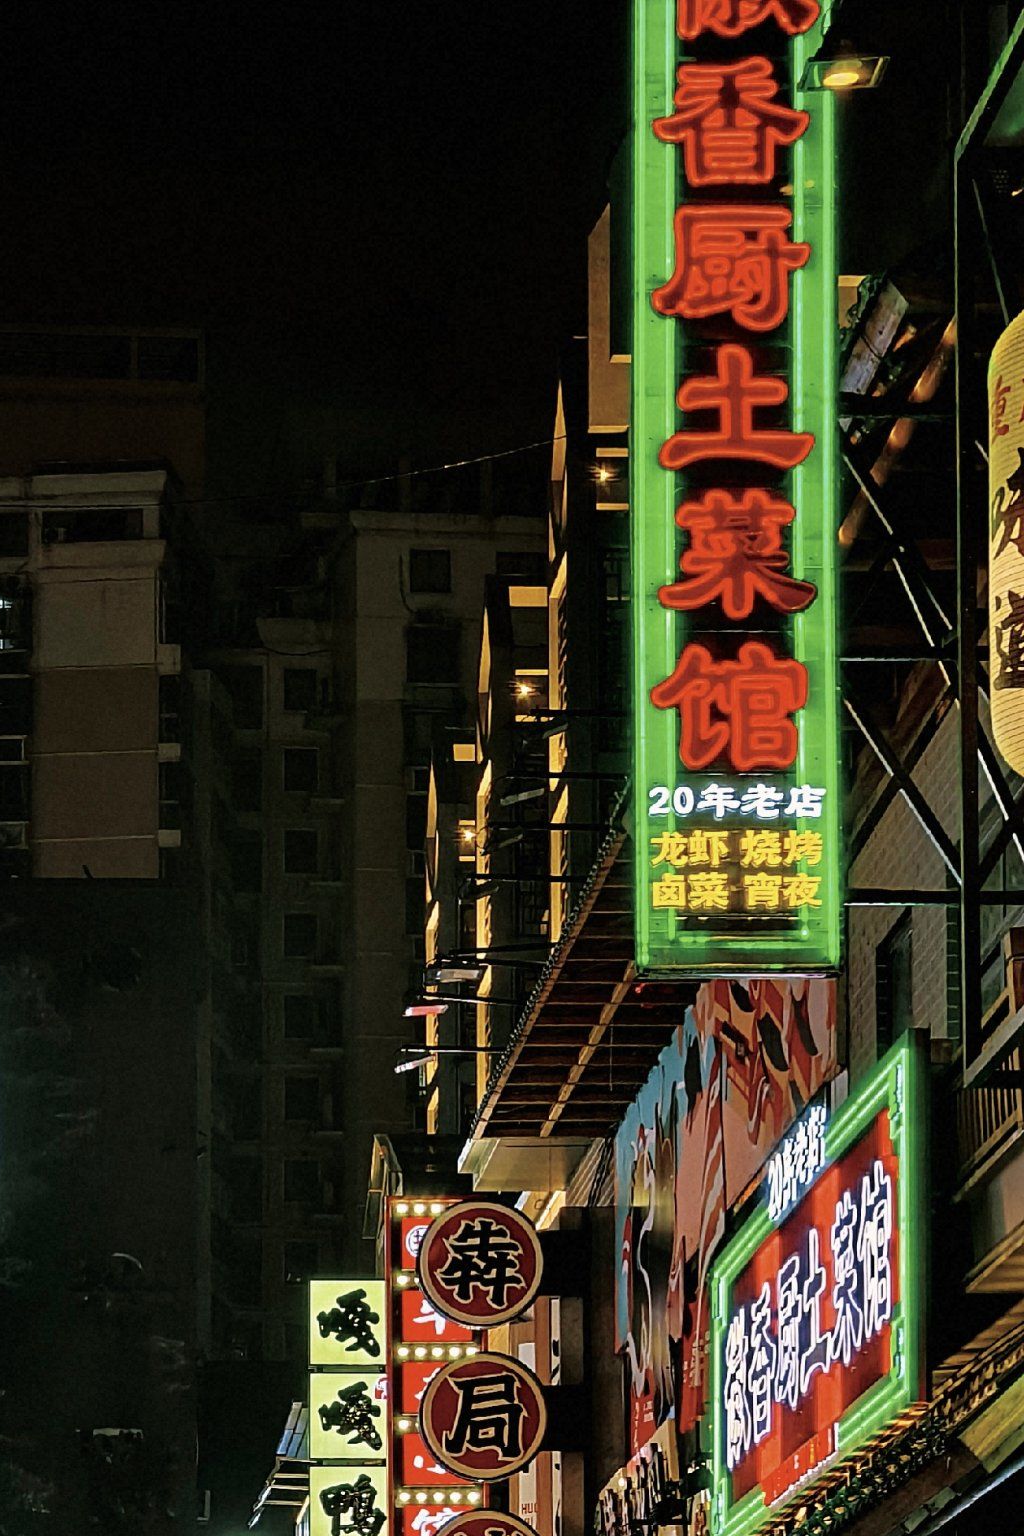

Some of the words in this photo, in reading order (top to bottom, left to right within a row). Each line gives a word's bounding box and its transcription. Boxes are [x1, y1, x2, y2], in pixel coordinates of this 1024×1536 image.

[648, 783, 826, 819] 20年老店
[650, 829, 729, 868] 龙虾
[740, 829, 823, 868] 烧烤
[651, 872, 729, 909] 卤菜
[743, 872, 823, 909] 宵夜
